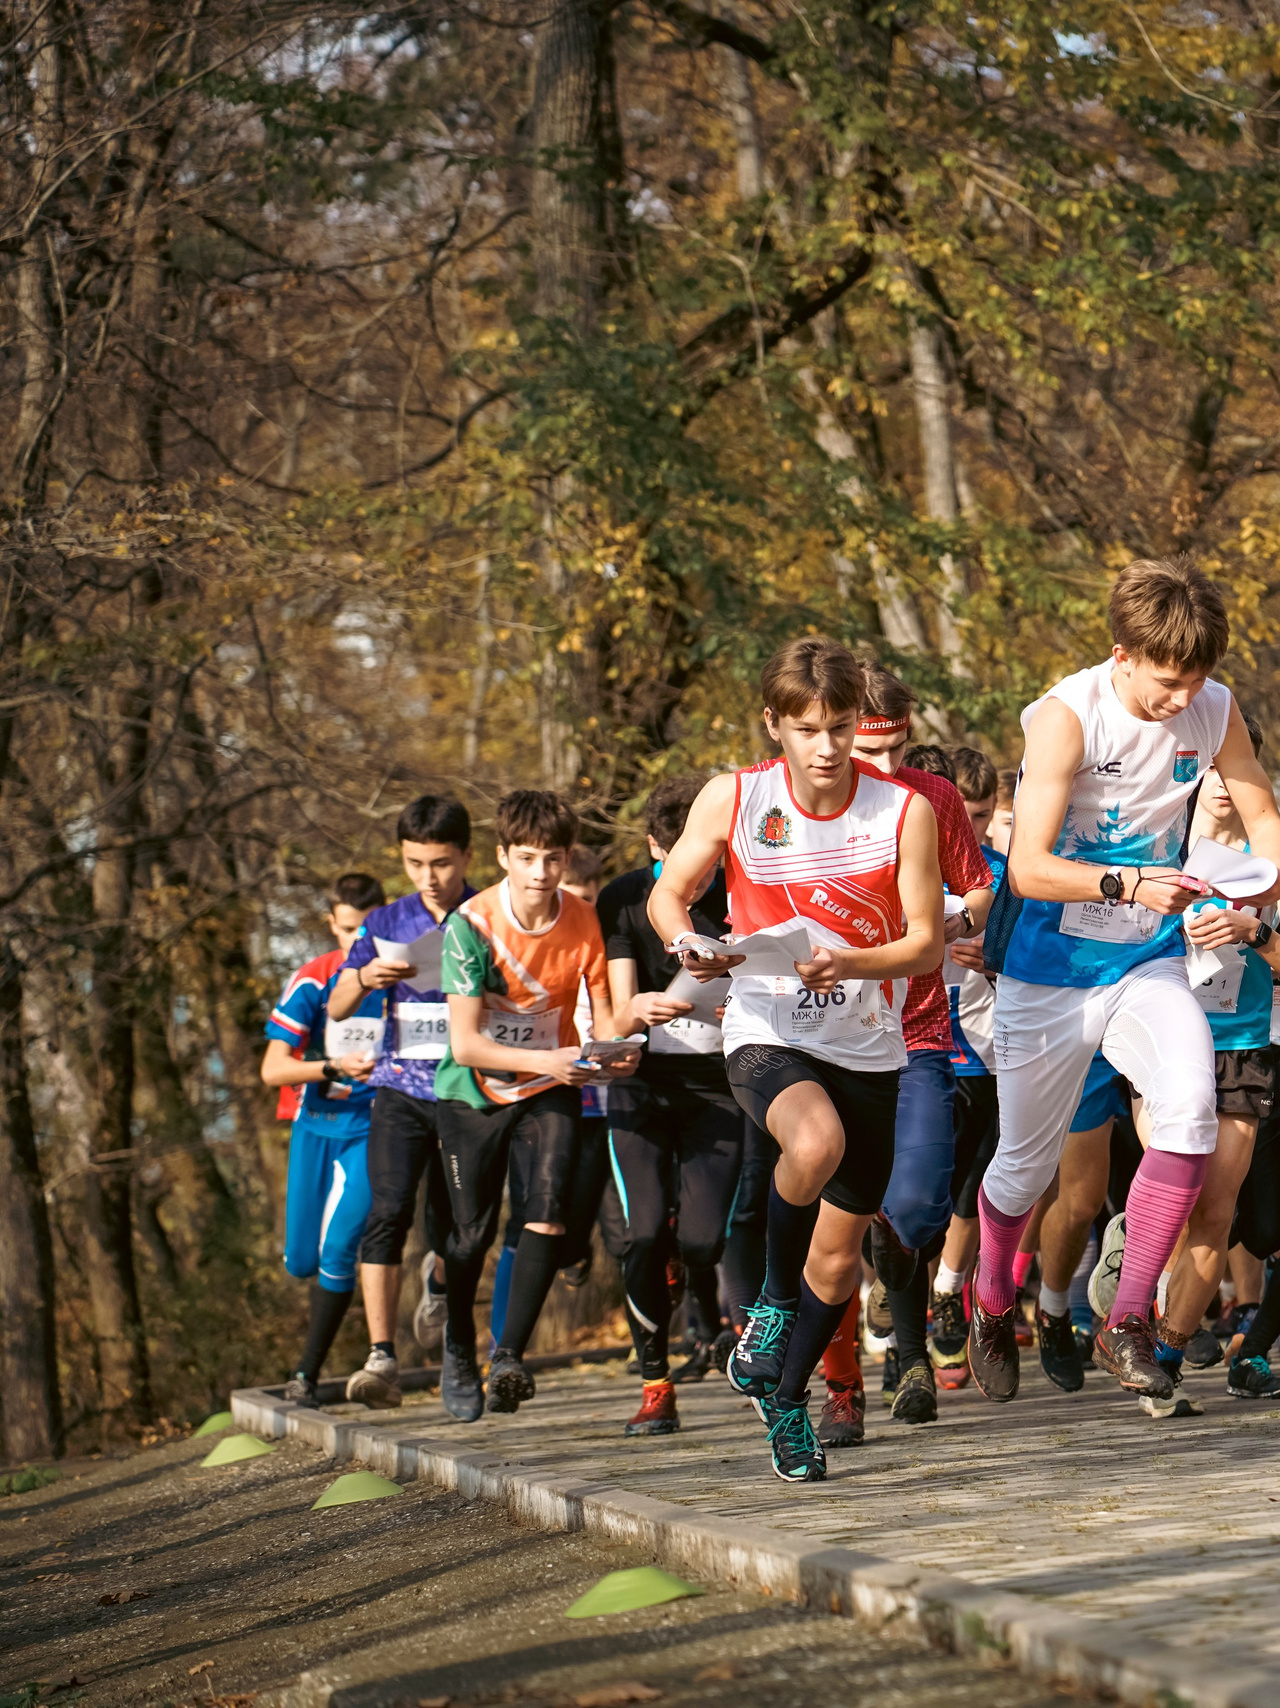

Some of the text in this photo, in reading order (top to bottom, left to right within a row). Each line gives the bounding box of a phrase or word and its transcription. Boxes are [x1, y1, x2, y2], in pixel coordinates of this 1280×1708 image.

[809, 888, 881, 942] Run and
[1082, 903, 1114, 918] МЖ16
[796, 984, 862, 1010] 206 1
[792, 1011, 825, 1021] МЖ16
[415, 1018, 448, 1034] 218
[495, 1024, 534, 1043] 212
[343, 1028, 376, 1042] 224
